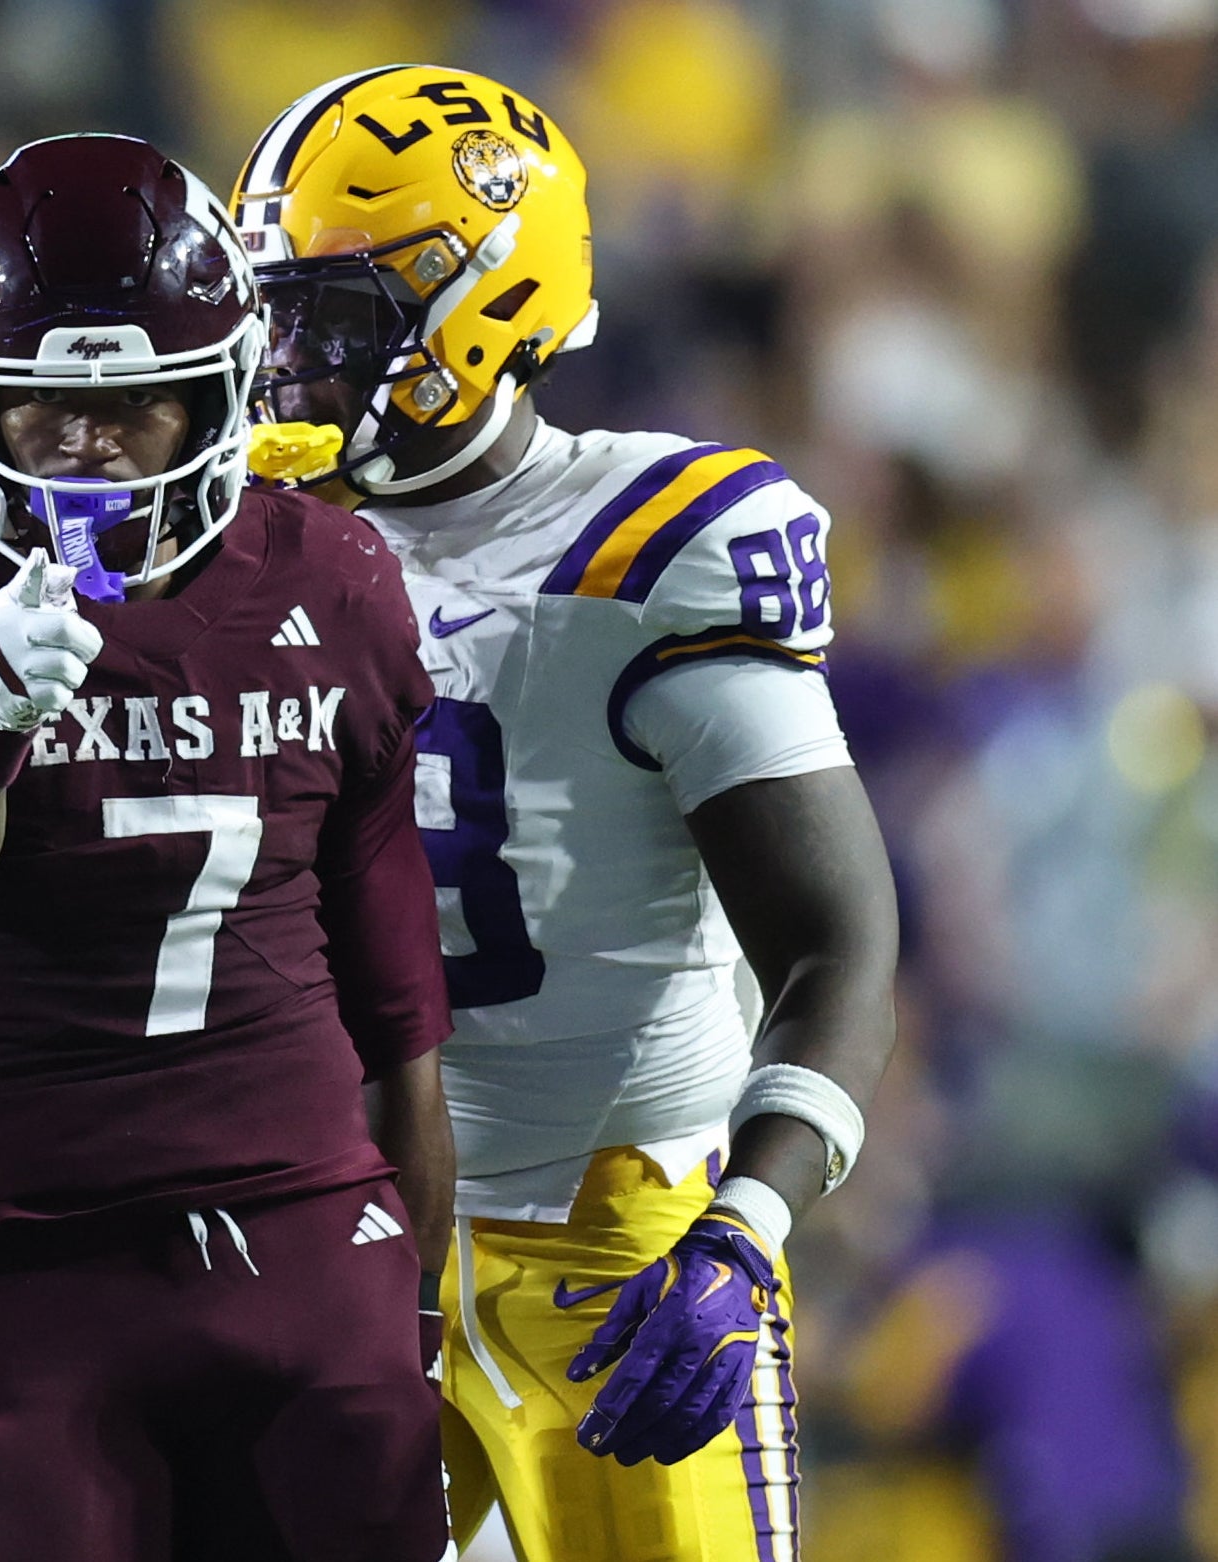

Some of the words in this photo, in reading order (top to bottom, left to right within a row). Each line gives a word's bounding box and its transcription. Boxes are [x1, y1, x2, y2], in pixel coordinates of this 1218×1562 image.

[354, 81, 550, 156] LSU
[66, 336, 123, 360] Aggies
[727, 512, 830, 640] 88
[30, 695, 216, 767] EXAS
[102, 795, 263, 1037] 7
